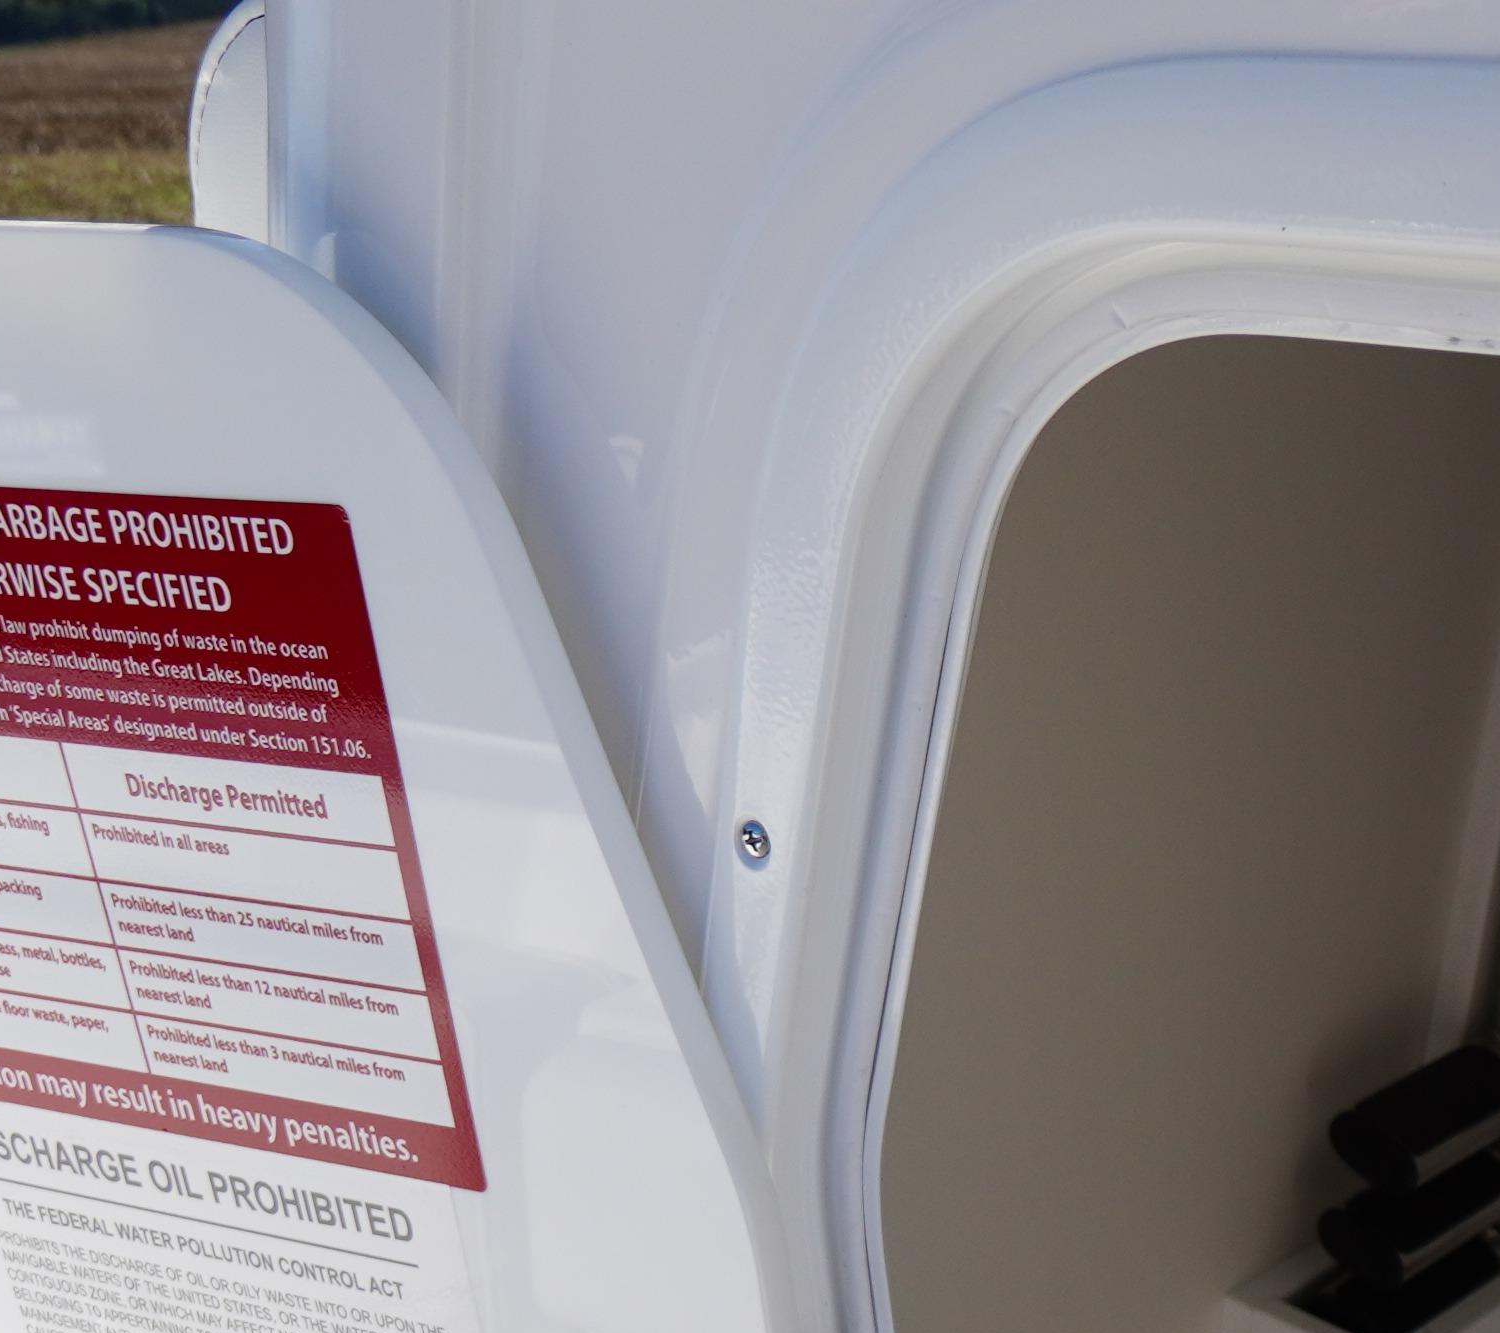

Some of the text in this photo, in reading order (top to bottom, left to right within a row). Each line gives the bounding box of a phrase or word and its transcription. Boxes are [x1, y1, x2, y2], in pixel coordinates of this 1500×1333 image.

[107, 509, 295, 556] PROHIBITED
[82, 567, 232, 613] SPECIFIED
[28, 618, 91, 641] prohibit
[91, 622, 163, 652] dumping
[162, 627, 180, 648] of
[181, 634, 229, 653] waste
[229, 633, 248, 654] in
[248, 635, 278, 657] the
[279, 642, 329, 661] ocean
[2, 645, 51, 668] States
[49, 648, 124, 679] including
[122, 655, 151, 677] the
[150, 658, 197, 681] Great
[195, 661, 248, 685] Lakes.
[247, 666, 341, 699] Depending
[45, 678, 63, 698] of
[63, 684, 106, 703] some
[105, 688, 152, 707] waste
[150, 688, 167, 709] is
[166, 693, 247, 716] permitted
[247, 700, 309, 723] outside
[309, 703, 329, 724] of
[113, 714, 199, 742] designated
[199, 725, 246, 747] under
[247, 728, 310, 753] Section
[310, 735, 372, 760] 151.06.
[124, 772, 329, 820] Discharge Permitted
[5, 811, 51, 837] fishing
[90, 822, 231, 857] Prohibited in all areas
[109, 892, 385, 947] Prohibited less than 25 nautical miles from
[117, 920, 196, 943] nearest land
[20, 946, 60, 964] metal,
[58, 949, 107, 971] bottles,
[128, 959, 400, 1017] Prohibited less than 12 nautical miles from
[135, 986, 213, 1010] nearest land
[30, 1007, 71, 1026] waste,
[70, 1014, 110, 1033] paper,
[145, 1023, 407, 1082] Prohibited less than 3 nautical miles from
[152, 1050, 229, 1074] nearest land
[35, 1072, 88, 1108] may
[91, 1082, 167, 1117] result
[166, 1088, 196, 1122] in
[195, 1094, 277, 1143] heavy
[282, 1117, 419, 1163] penalties.
[147, 1159, 204, 1201] OIL
[206, 1170, 414, 1243] PROHIBITED
[2, 1197, 403, 1301] THE FEDERAL WATER POLLUTION CONTROL ACT
